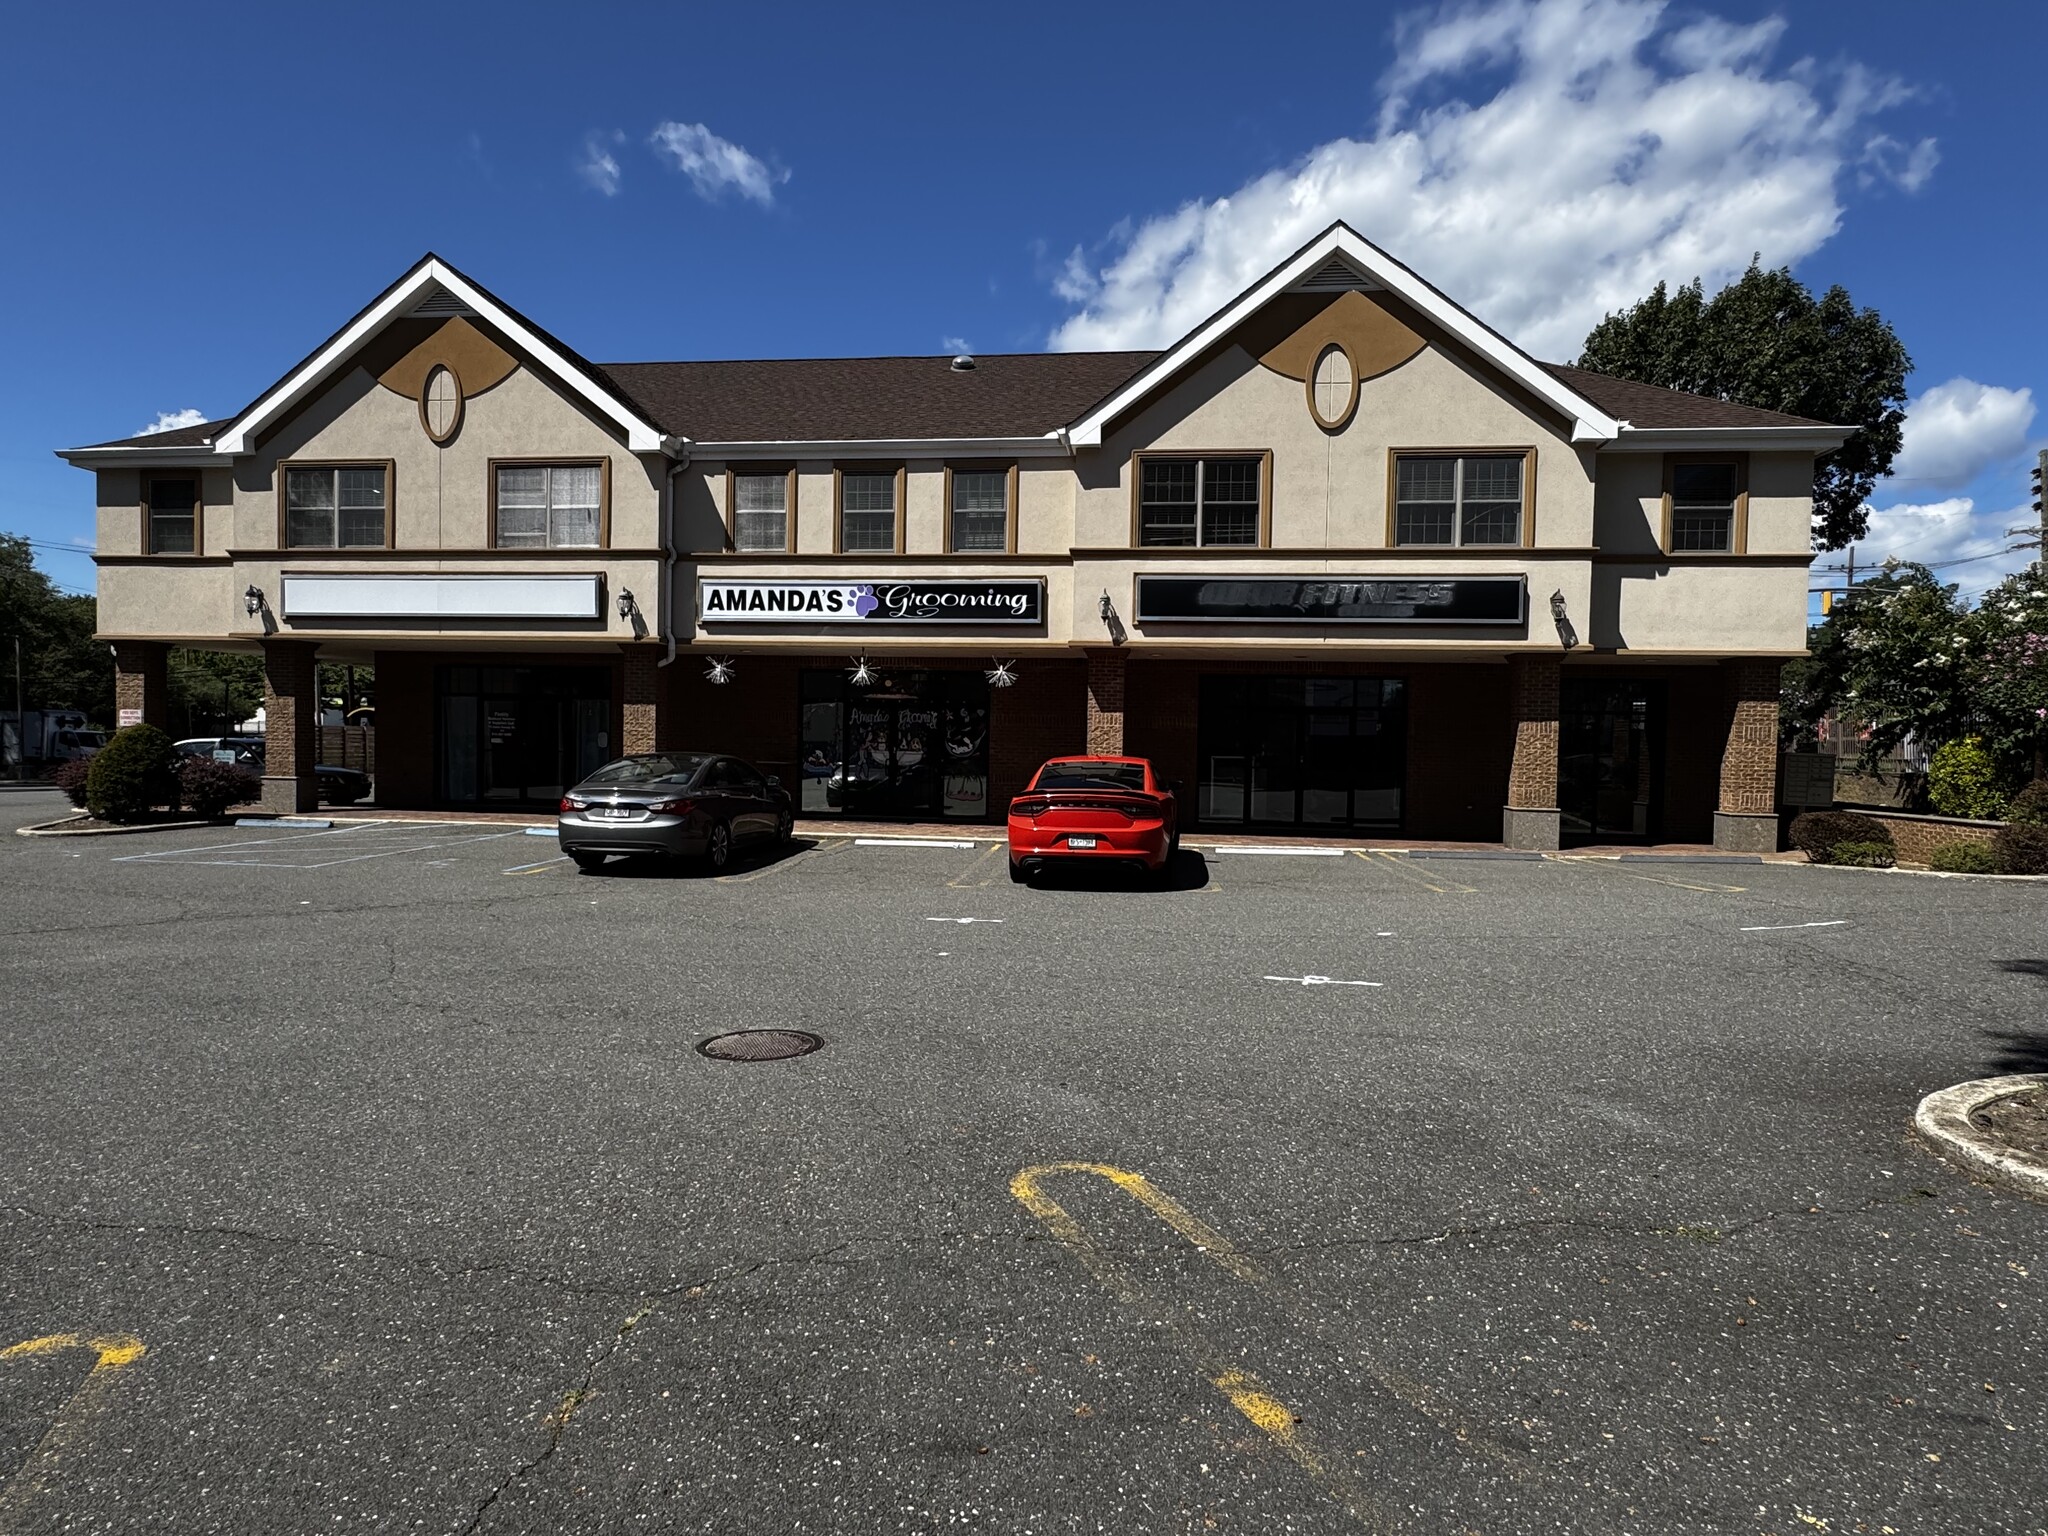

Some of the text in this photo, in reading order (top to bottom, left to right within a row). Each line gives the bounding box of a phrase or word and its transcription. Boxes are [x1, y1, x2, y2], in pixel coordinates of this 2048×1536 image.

[706, 584, 1035, 618] AMANDA'S Grooming
[1300, 582, 1455, 605] FITNESS
